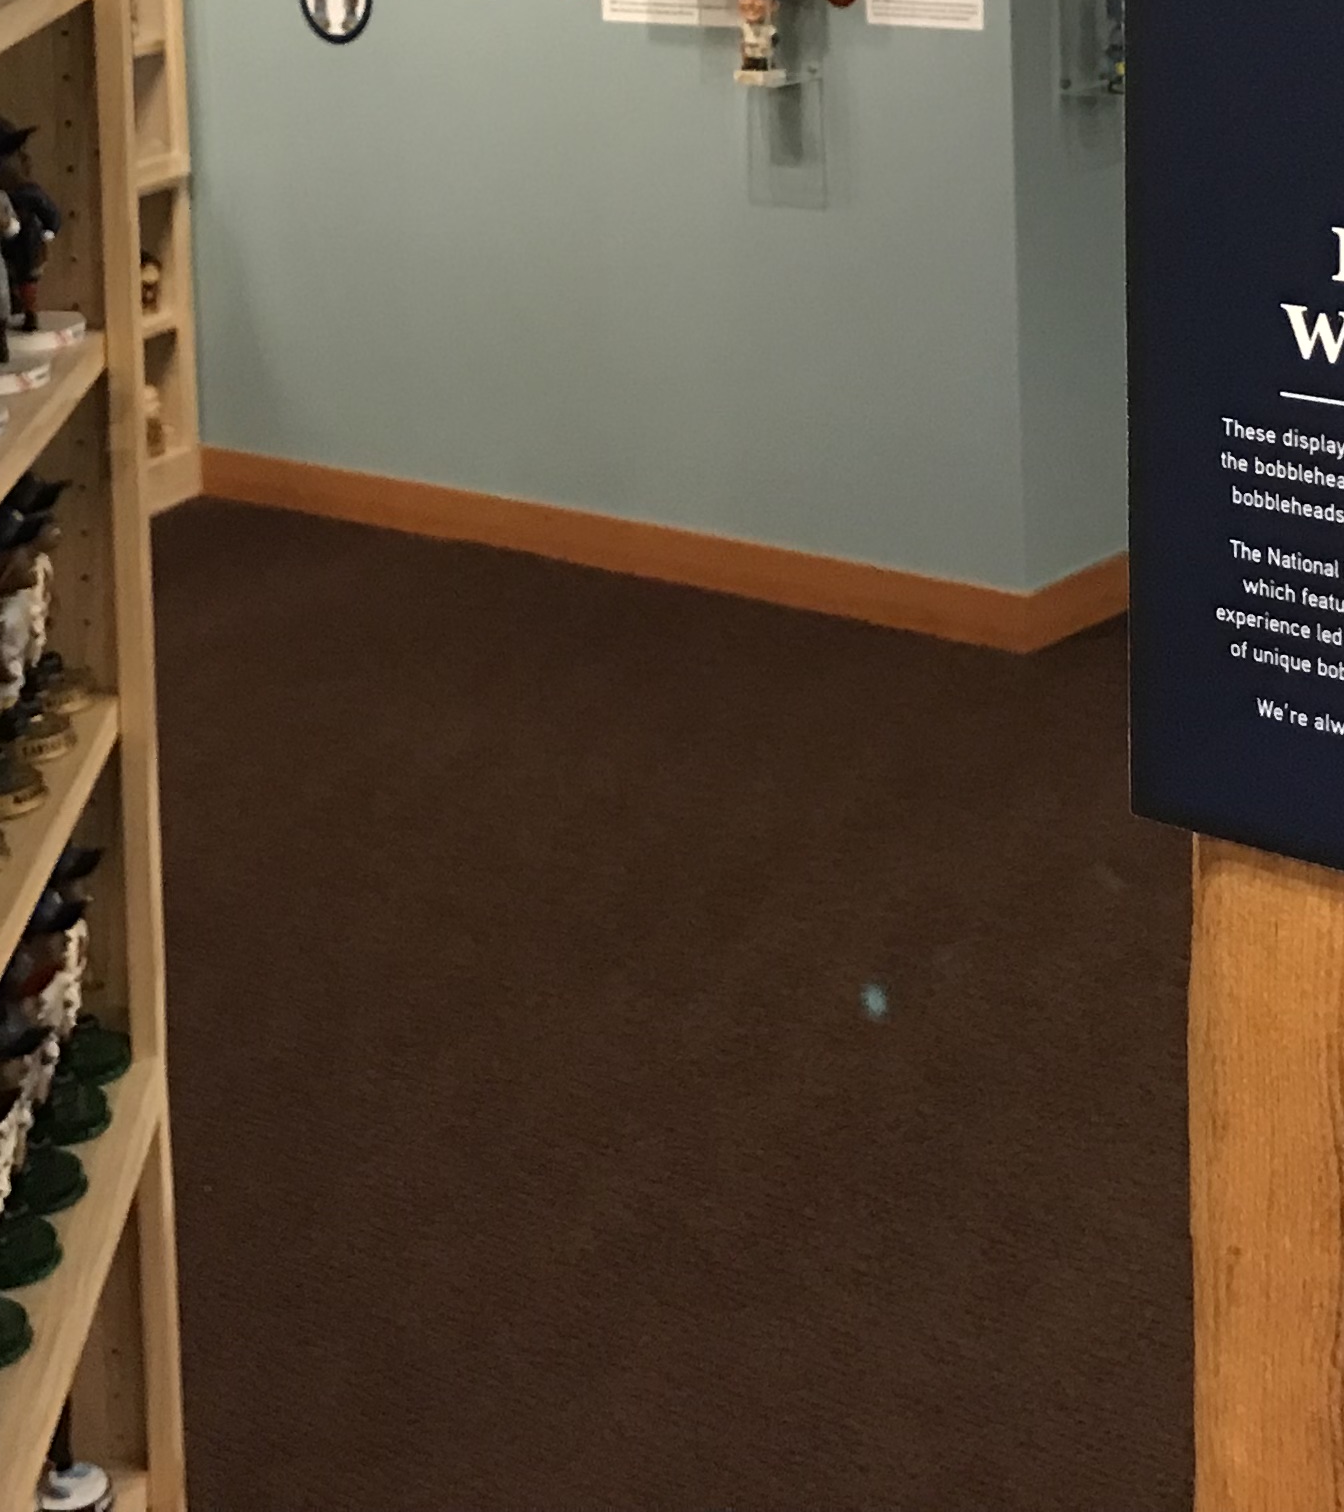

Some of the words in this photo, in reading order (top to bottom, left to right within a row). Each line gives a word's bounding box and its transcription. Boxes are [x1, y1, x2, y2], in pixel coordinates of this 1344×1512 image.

[1221, 416, 1277, 444] These
[1220, 451, 1249, 473] the
[1229, 538, 1262, 563] The
[1267, 546, 1340, 579] National
[1242, 578, 1296, 603] which
[1215, 607, 1311, 639] experience
[1316, 622, 1343, 646] led
[1230, 640, 1248, 659] of
[1253, 647, 1312, 674] unique
[1256, 697, 1309, 727] We're
